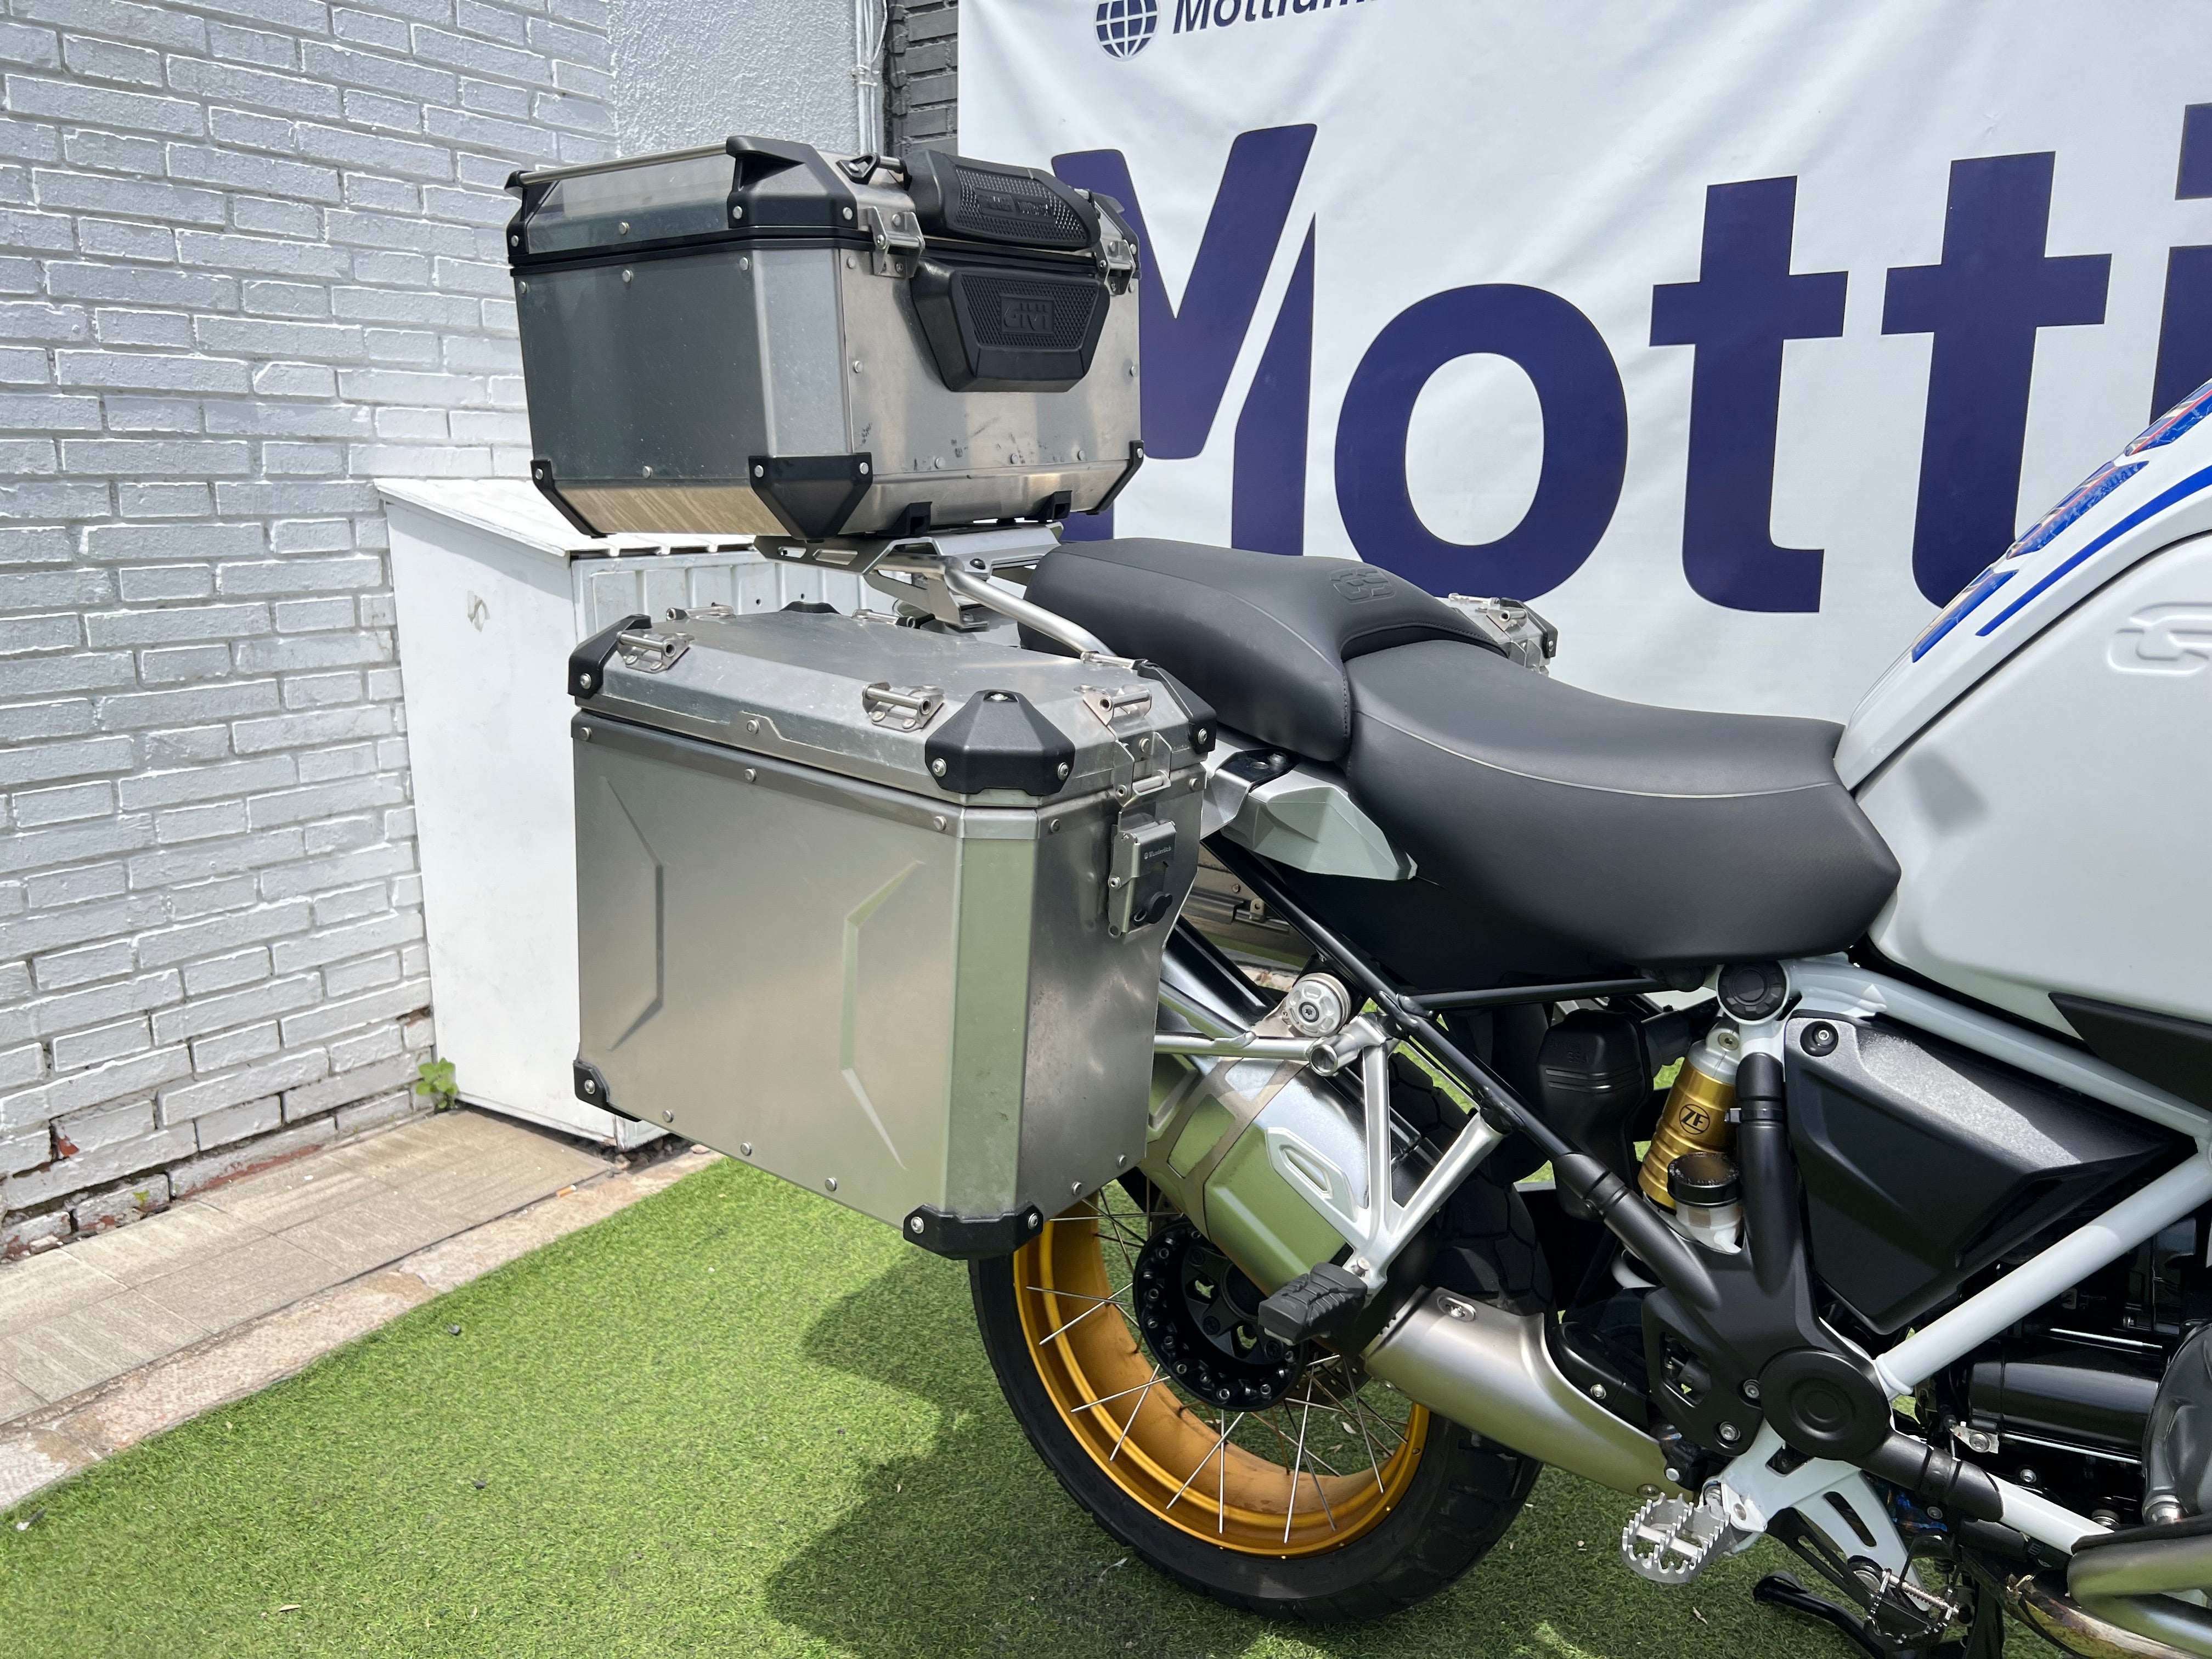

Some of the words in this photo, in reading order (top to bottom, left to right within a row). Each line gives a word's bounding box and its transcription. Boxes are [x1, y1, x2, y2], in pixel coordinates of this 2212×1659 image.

[1173, 0, 1366, 34] Mott
[1052, 103, 2212, 613] Mott
[1680, 1105, 1710, 1133] ZF
